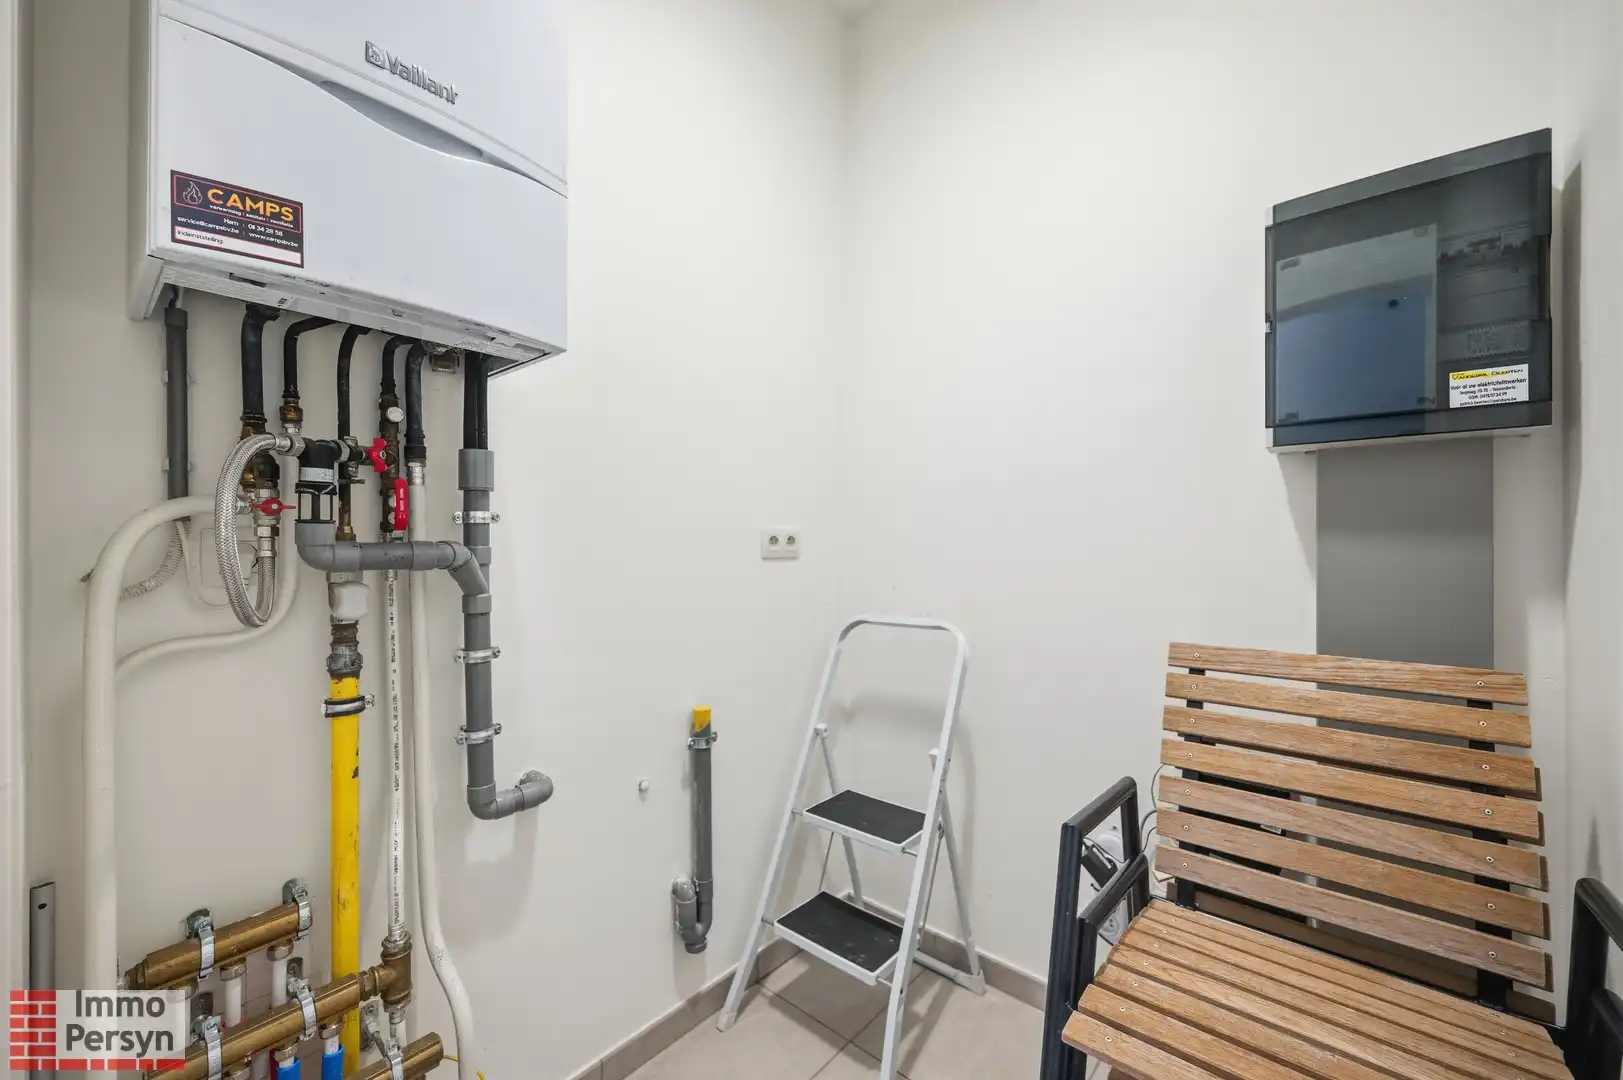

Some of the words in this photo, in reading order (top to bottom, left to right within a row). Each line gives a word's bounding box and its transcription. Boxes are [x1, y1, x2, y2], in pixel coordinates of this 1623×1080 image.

[385, 49, 459, 105] Vaillant
[207, 188, 294, 222] CAMPS
[209, 204, 242, 216] verwarming
